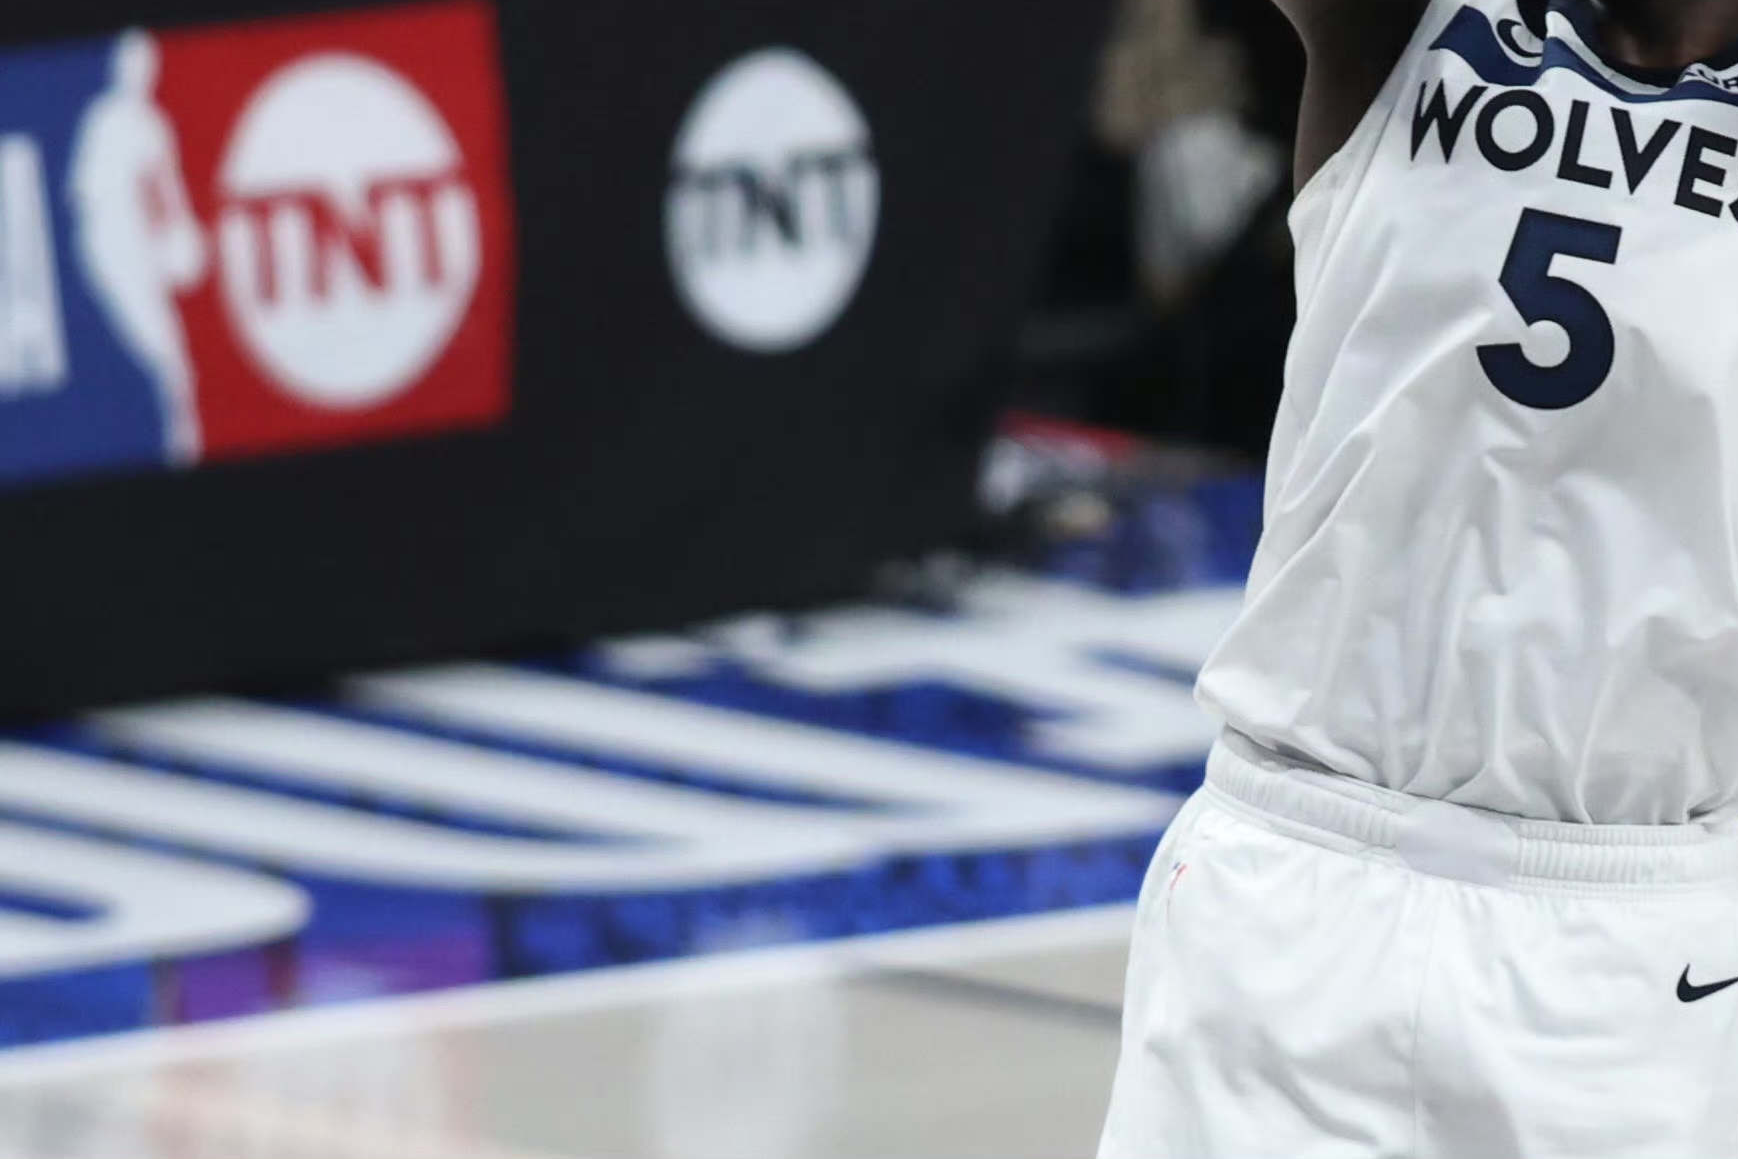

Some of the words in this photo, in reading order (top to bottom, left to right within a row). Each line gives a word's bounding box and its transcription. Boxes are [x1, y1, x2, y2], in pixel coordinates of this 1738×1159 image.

[221, 174, 465, 308] TNT
[670, 148, 873, 262] TNT
[1475, 206, 1623, 411] 5
